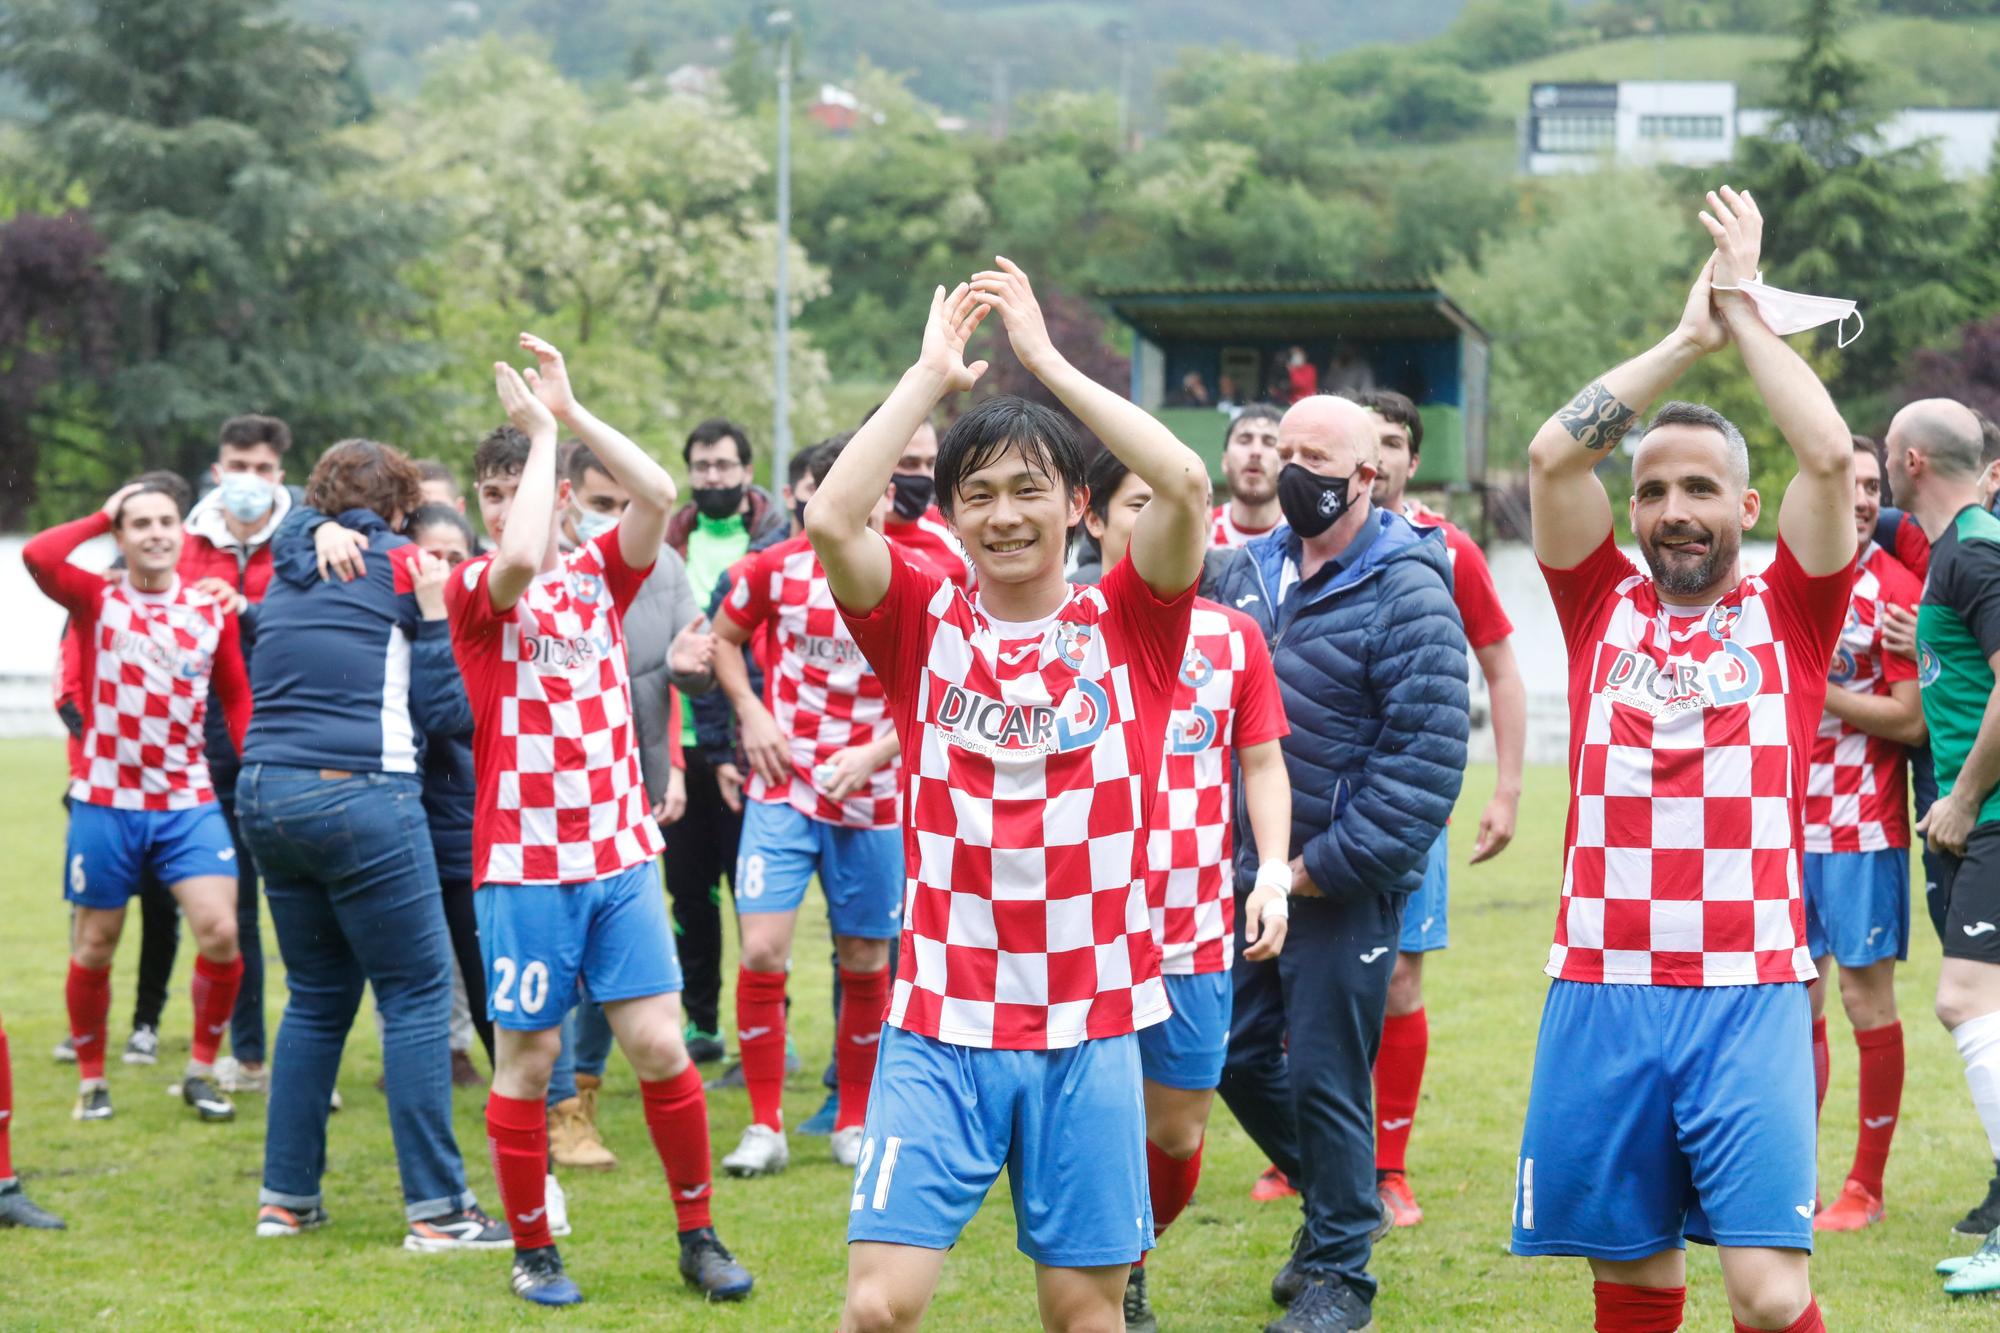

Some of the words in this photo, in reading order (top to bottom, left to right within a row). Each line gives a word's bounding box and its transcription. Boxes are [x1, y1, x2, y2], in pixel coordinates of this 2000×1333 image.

[938, 686, 1057, 744] DICAR
[493, 956, 549, 1014] 20
[851, 1136, 902, 1211] 21
